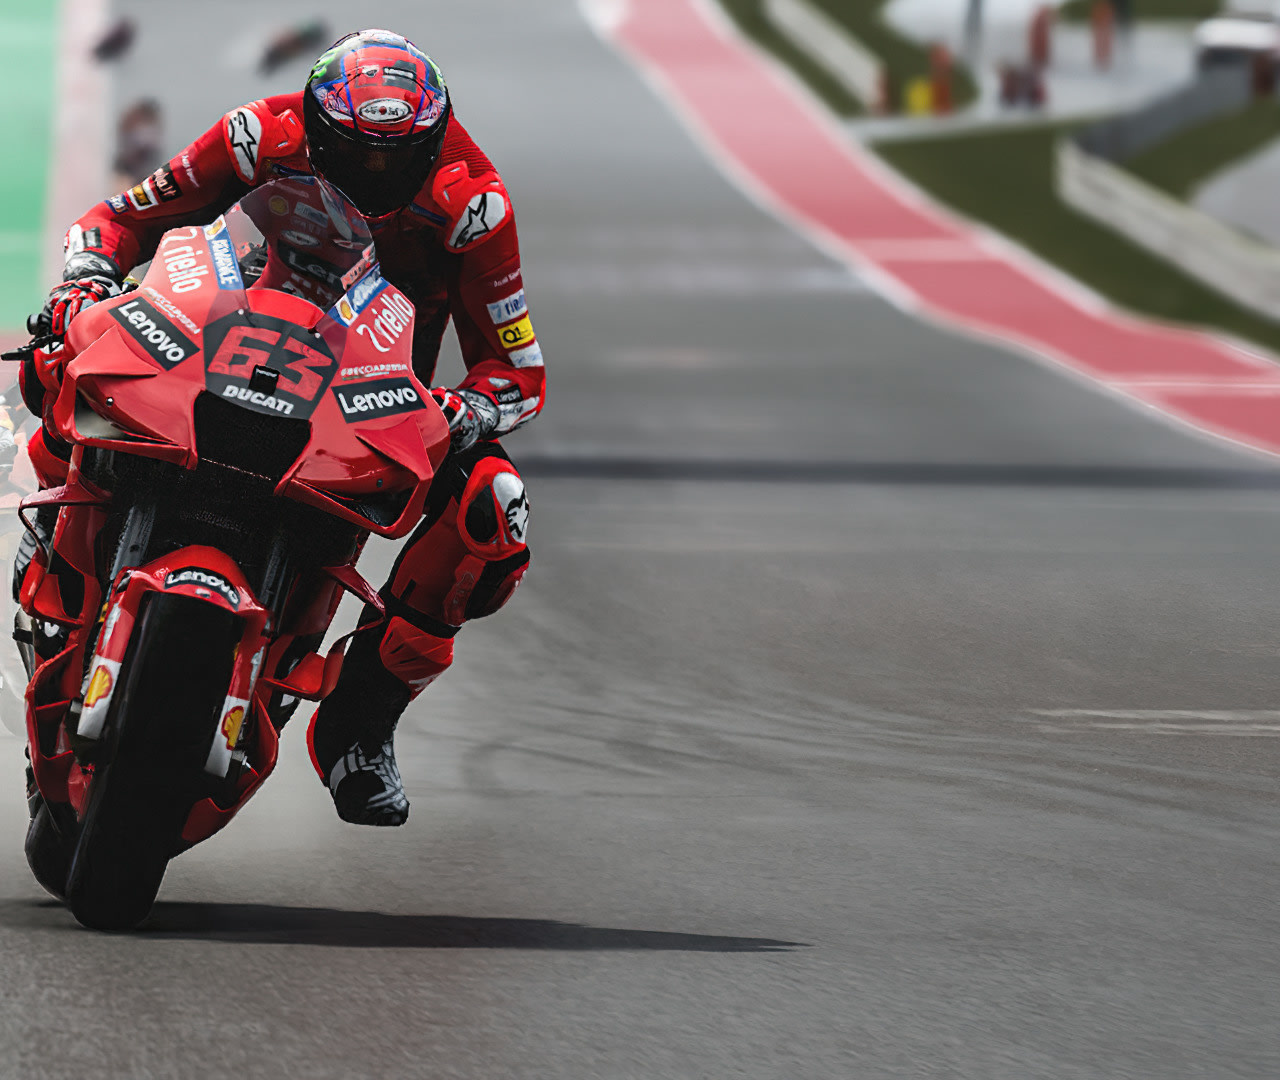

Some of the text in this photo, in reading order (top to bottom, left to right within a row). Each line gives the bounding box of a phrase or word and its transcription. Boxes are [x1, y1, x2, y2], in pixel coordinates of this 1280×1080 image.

[163, 246, 209, 293] riello
[118, 301, 185, 361] Lenovo
[374, 293, 414, 345] riello
[207, 325, 333, 401] 63
[222, 385, 294, 414] DUCATI
[338, 387, 417, 413] Lenovo
[166, 571, 239, 604] Lenovo
